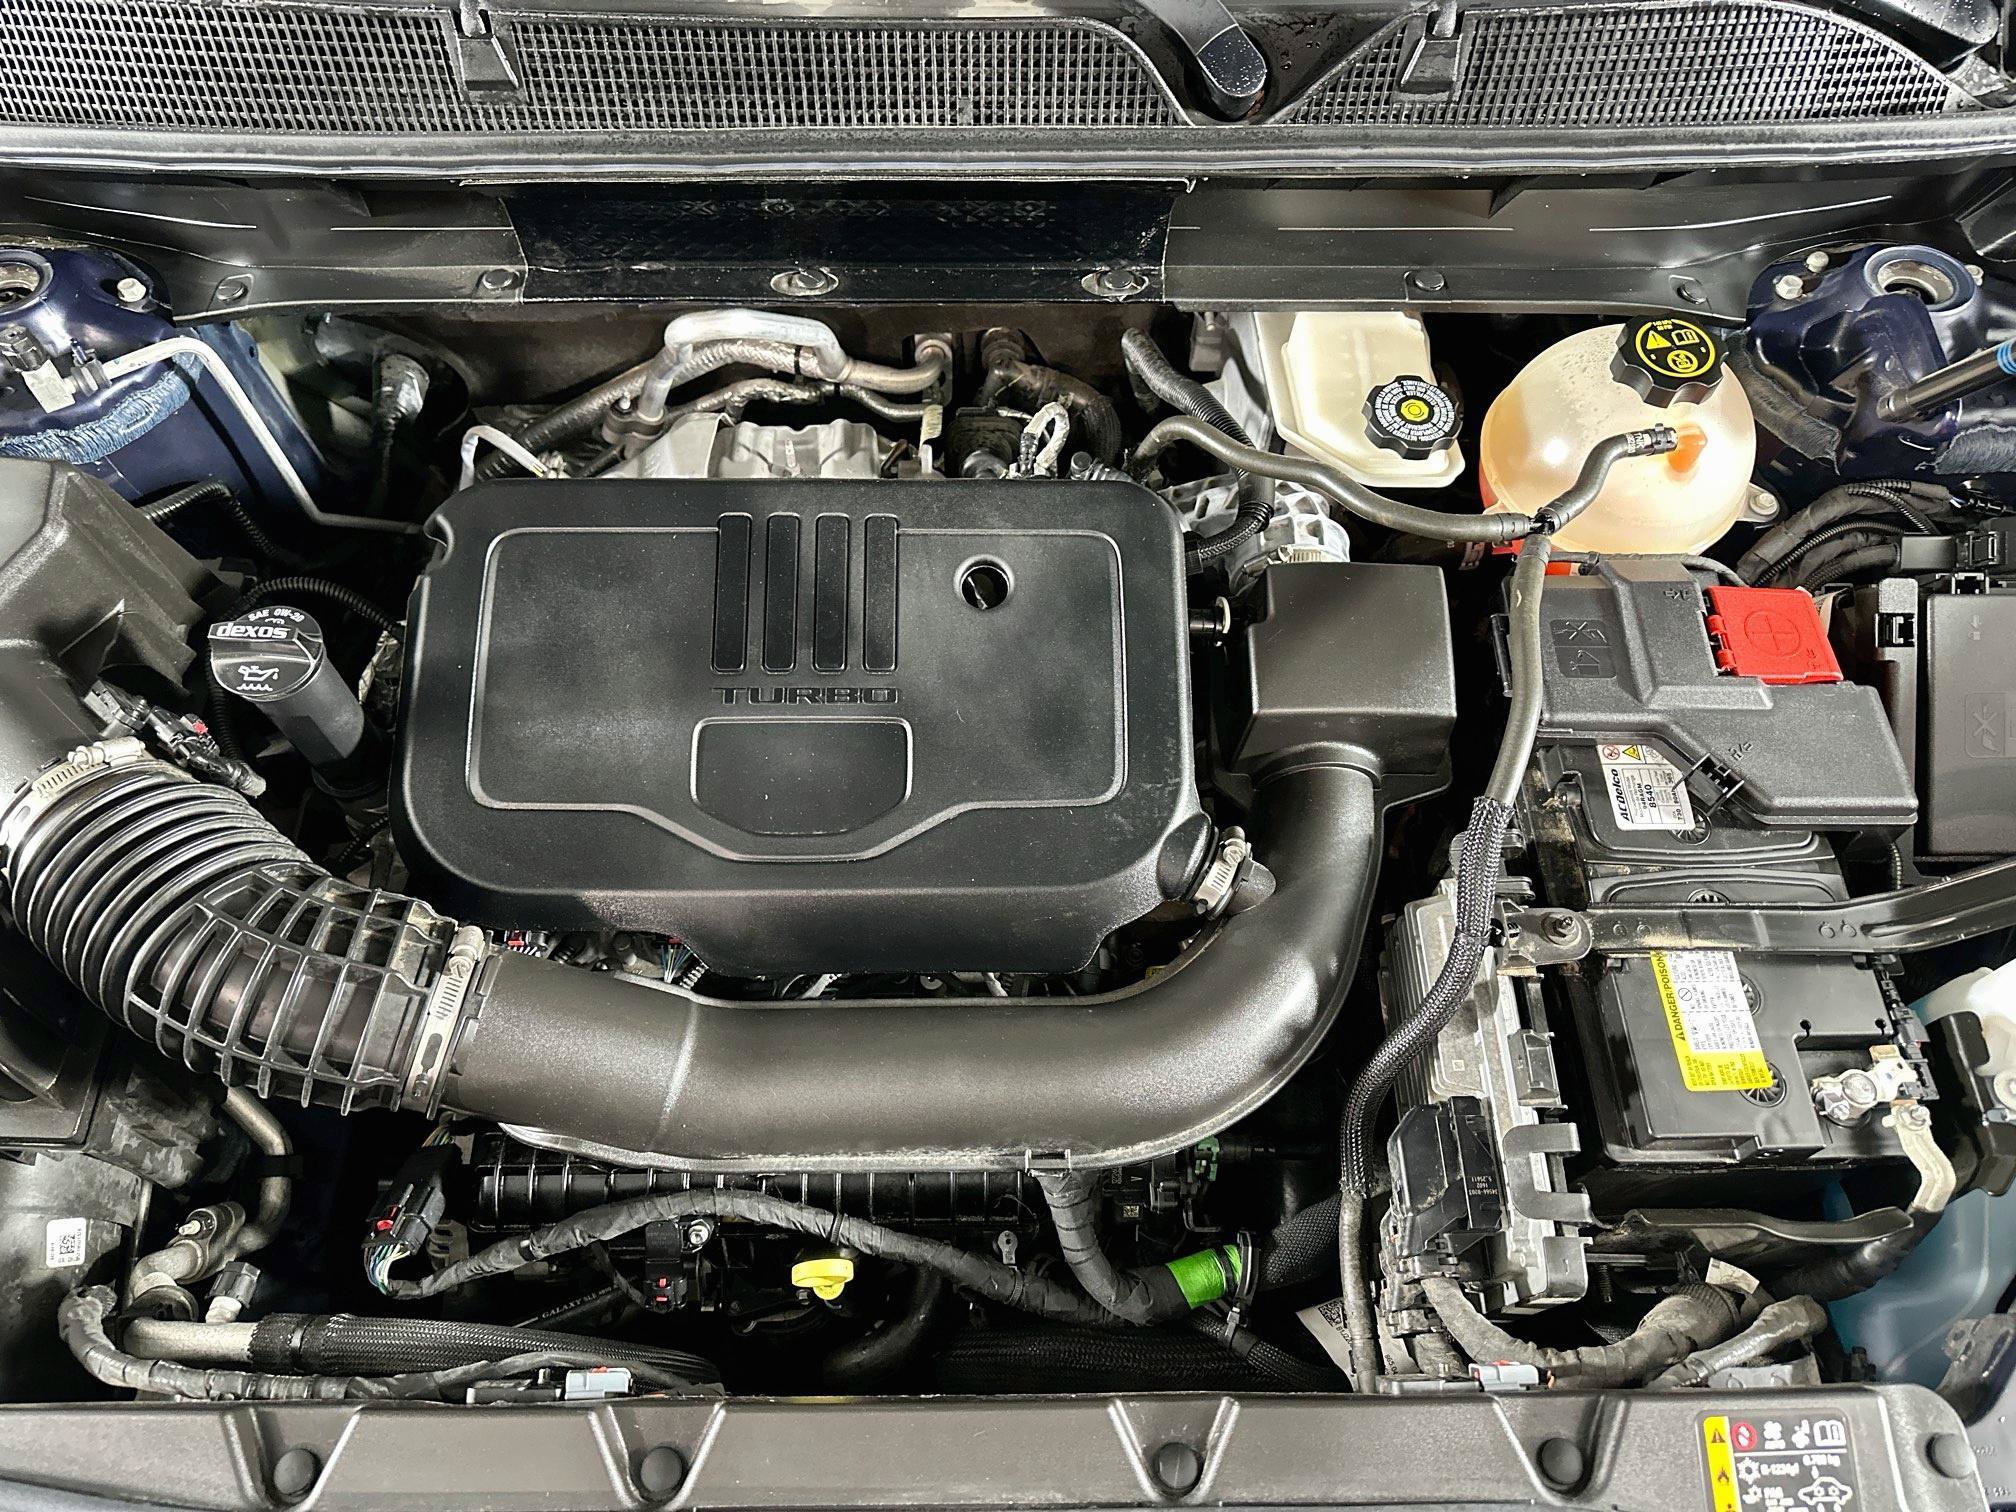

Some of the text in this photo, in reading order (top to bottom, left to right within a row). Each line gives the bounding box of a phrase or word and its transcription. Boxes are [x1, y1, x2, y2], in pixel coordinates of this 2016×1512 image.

[247, 608, 305, 623] SAE 0W-20
[216, 622, 291, 639] dexos
[711, 687, 901, 706] TURBO
[1610, 768, 1630, 822] ACDelco
[1644, 783, 1657, 809] 8540
[542, 1299, 581, 1319] GALAXY
